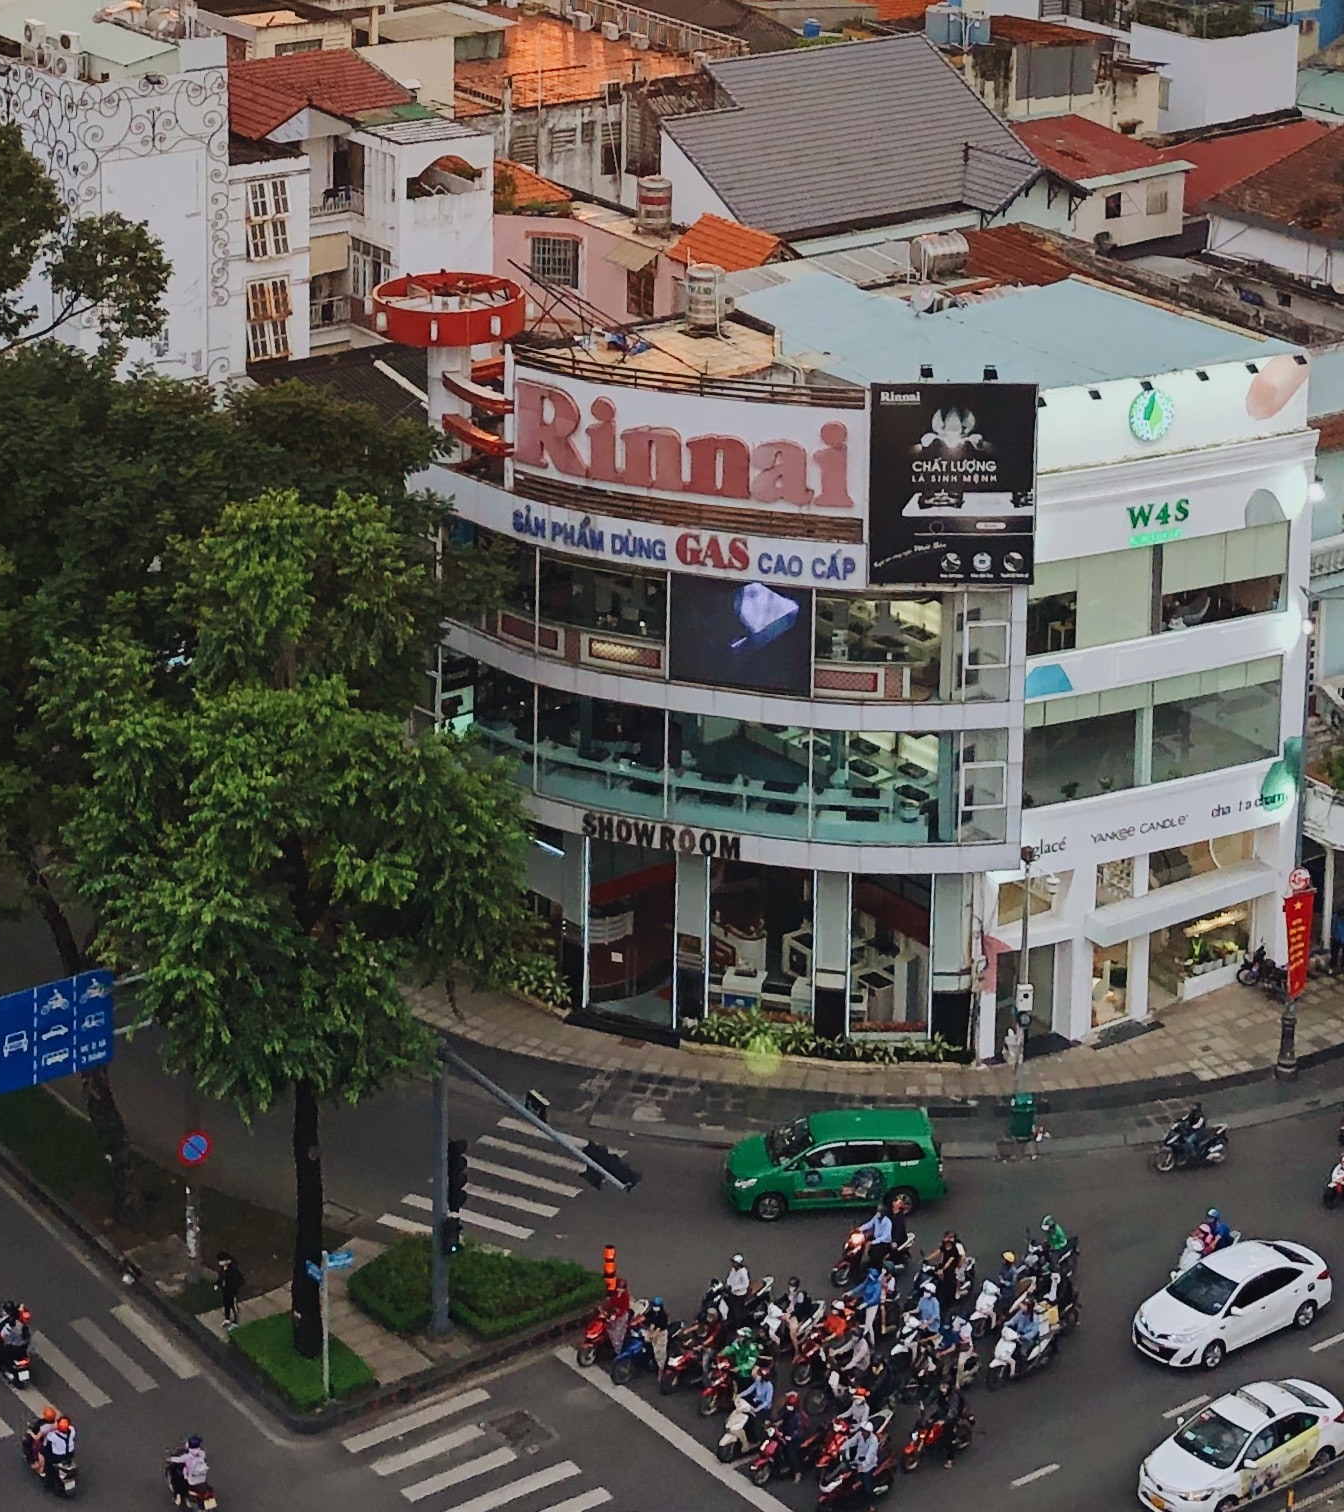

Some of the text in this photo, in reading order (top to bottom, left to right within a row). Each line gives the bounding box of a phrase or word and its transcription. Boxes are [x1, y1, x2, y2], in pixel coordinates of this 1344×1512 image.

[880, 391, 921, 402] Rinnai
[514, 377, 854, 507] Rinnai
[912, 457, 997, 474] CHẤT LƯỢNG
[930, 474, 958, 483] SINH
[962, 474, 998, 484] MỆNH
[1126, 498, 1190, 529] W4S
[512, 504, 547, 539] SẢN
[551, 516, 605, 553] PHẨM
[611, 528, 667, 561] DÙNG
[675, 532, 750, 571] GAS
[758, 553, 804, 577] CAO
[811, 549, 857, 581] CẤP
[582, 810, 741, 860] SHOWROOM
